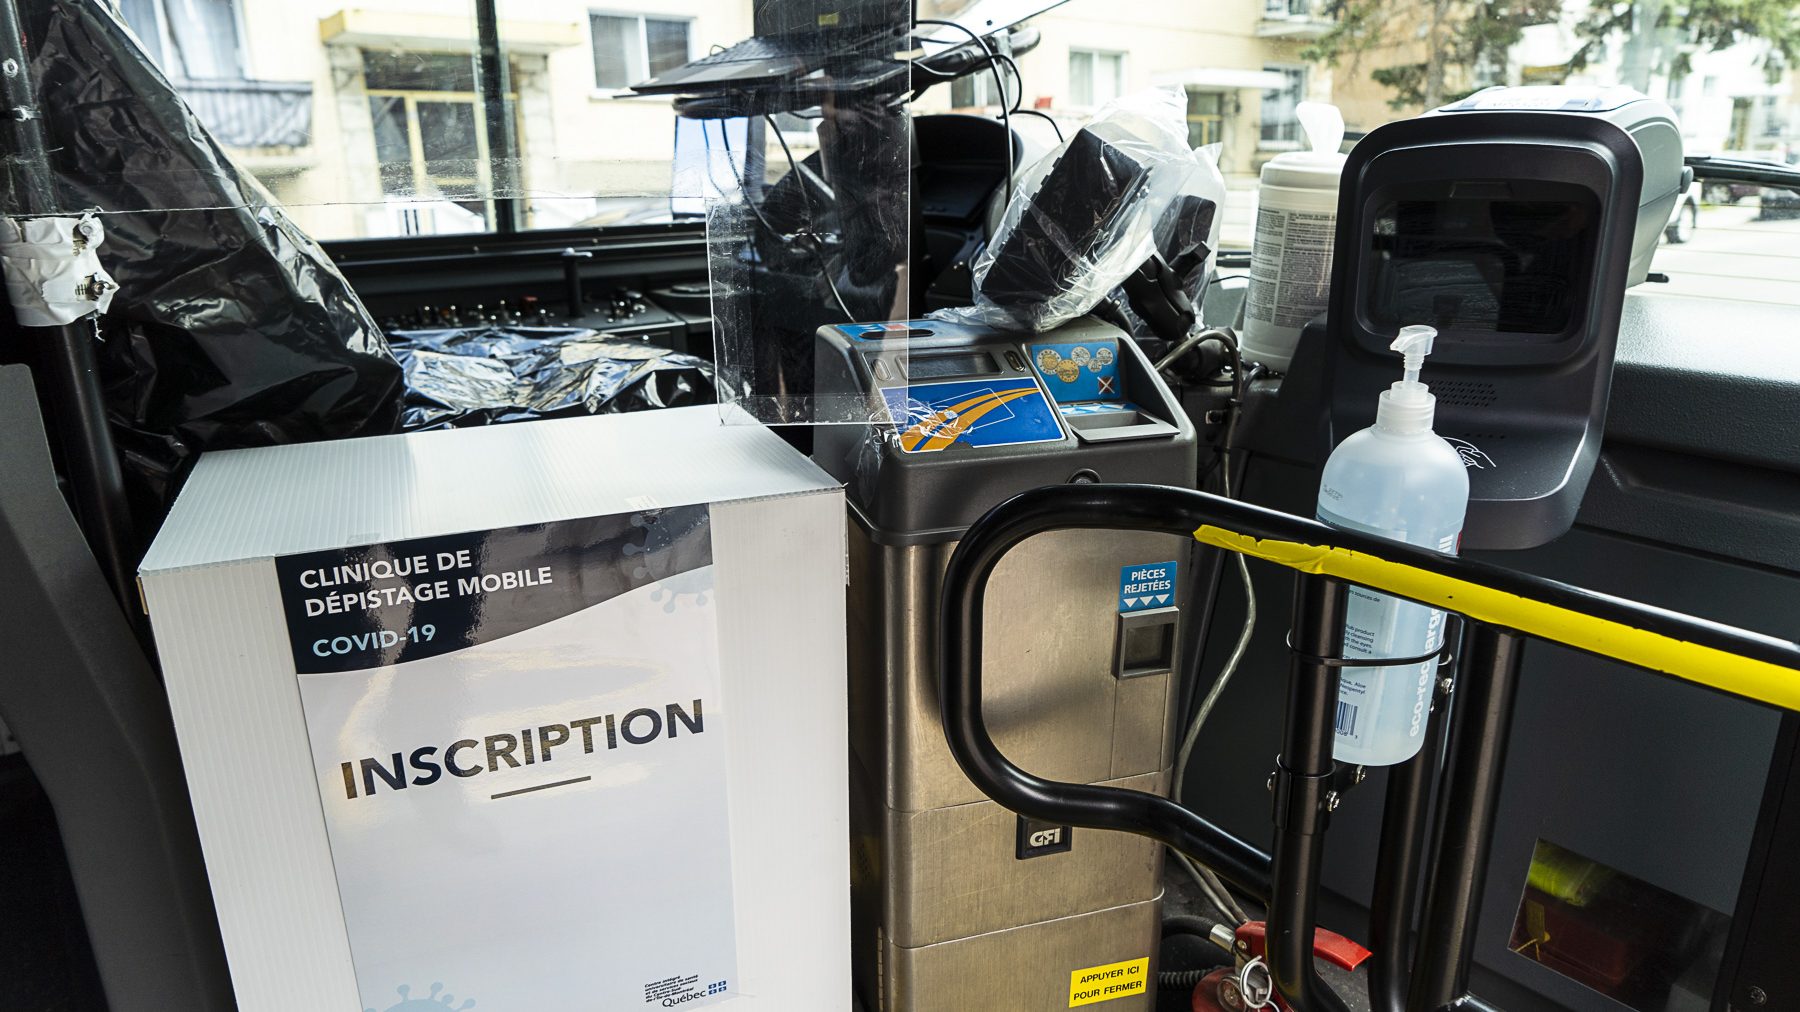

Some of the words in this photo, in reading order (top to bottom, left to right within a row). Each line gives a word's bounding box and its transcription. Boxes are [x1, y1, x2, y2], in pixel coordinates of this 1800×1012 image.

[300, 554, 428, 589] CLINIQUE
[437, 549, 472, 570] DE
[1131, 568, 1166, 581] PIÈCES
[305, 580, 450, 617] DÉPISTAGE
[458, 566, 553, 596] MOBILE
[1124, 579, 1171, 594] REJETÉES
[312, 623, 436, 658] COVID-19
[340, 699, 704, 799] INSCRIPTION
[1080, 968, 1124, 984] APPUYER
[1127, 965, 1140, 975] ICI
[662, 990, 707, 1007] Québec
[1073, 989, 1100, 1000] POUR
[1103, 980, 1142, 995] FERMER
